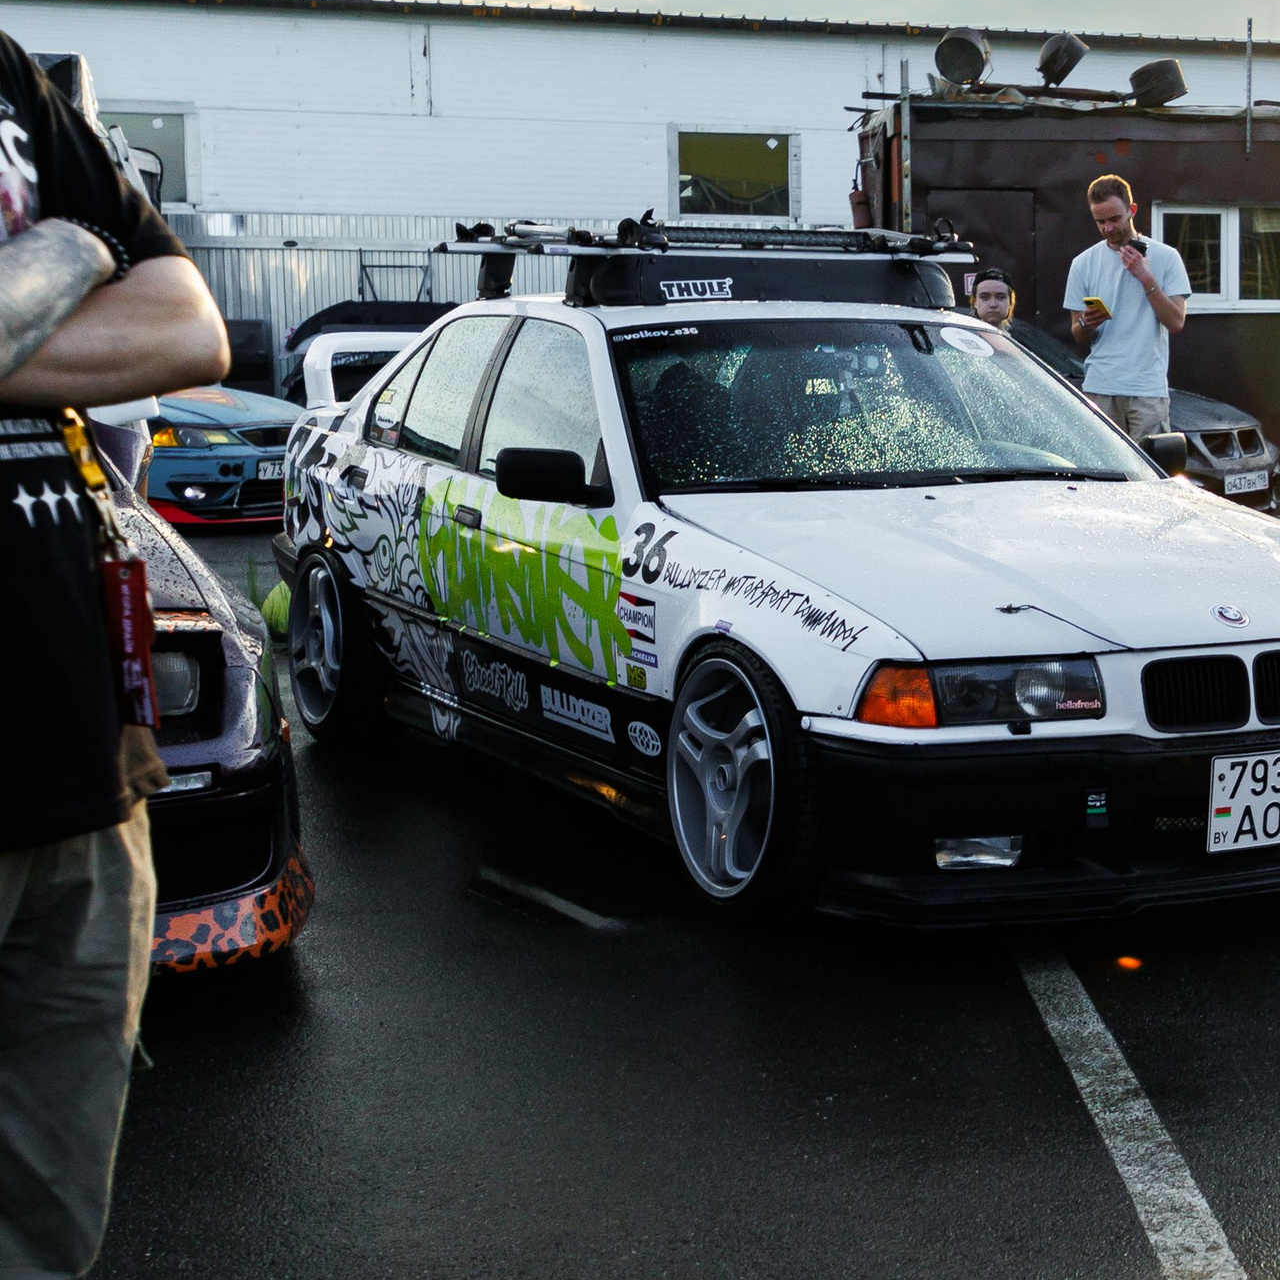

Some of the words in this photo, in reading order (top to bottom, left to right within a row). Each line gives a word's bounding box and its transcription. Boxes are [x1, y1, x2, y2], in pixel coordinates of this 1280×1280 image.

[661, 279, 731, 299] THULE
[622, 522, 679, 584] 36
[663, 561, 727, 591] BULLDOZER
[720, 575, 805, 613] MOTORSPORT
[793, 595, 869, 652] COMMANDOS
[619, 606, 654, 630] CHAMPION
[631, 649, 656, 664] ICHELIN
[540, 684, 613, 735] BULLDOZER
[1055, 699, 1101, 710] hellafresh
[1213, 831, 1229, 844] BY
